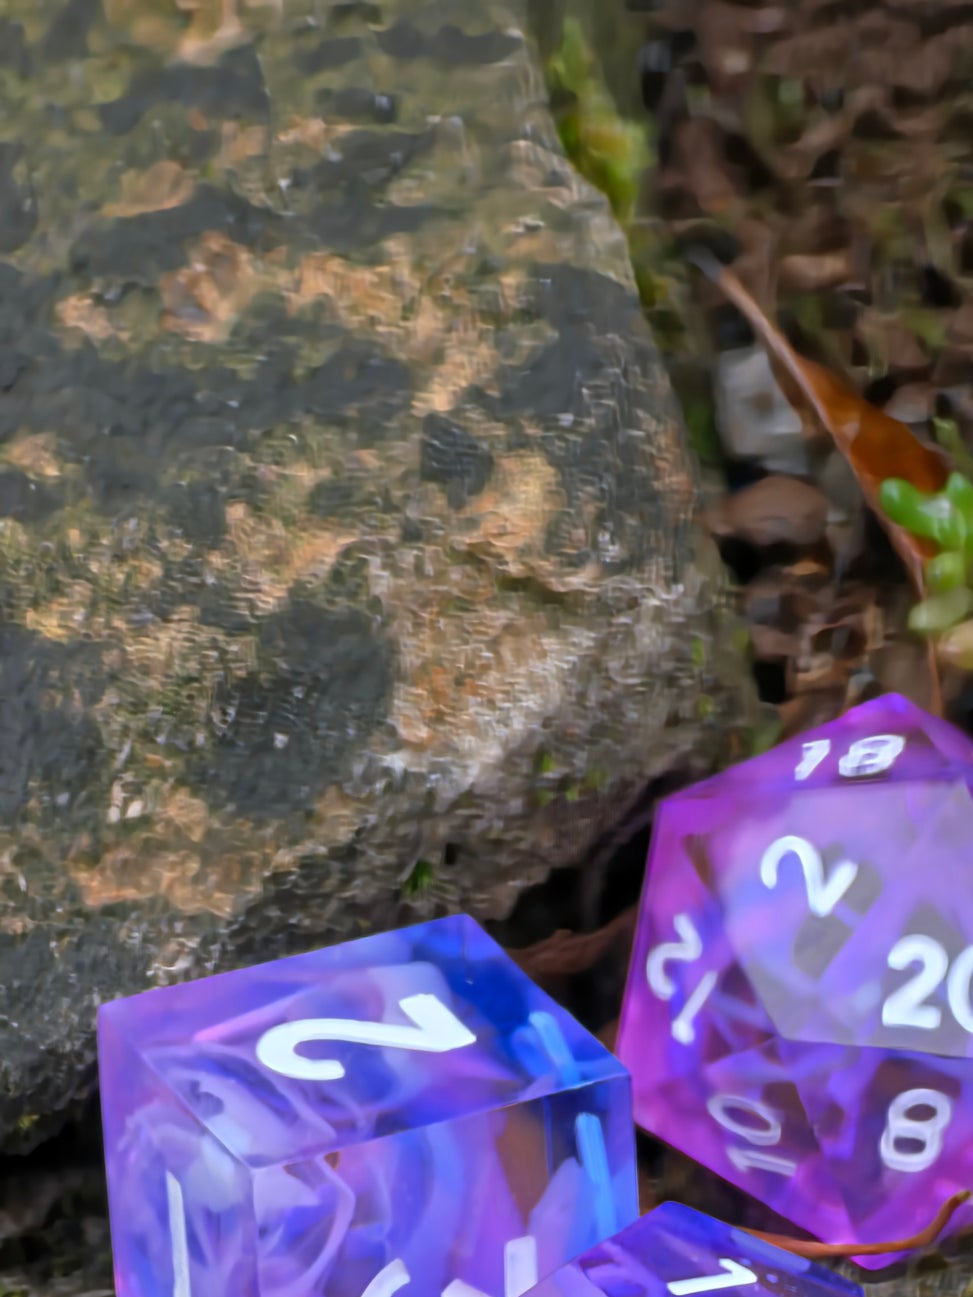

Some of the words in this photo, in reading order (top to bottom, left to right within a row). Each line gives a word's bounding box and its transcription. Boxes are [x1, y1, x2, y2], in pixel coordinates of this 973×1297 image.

[760, 835, 857, 917] 2
[256, 994, 477, 1081] 2
[879, 1088, 951, 1173] 8
